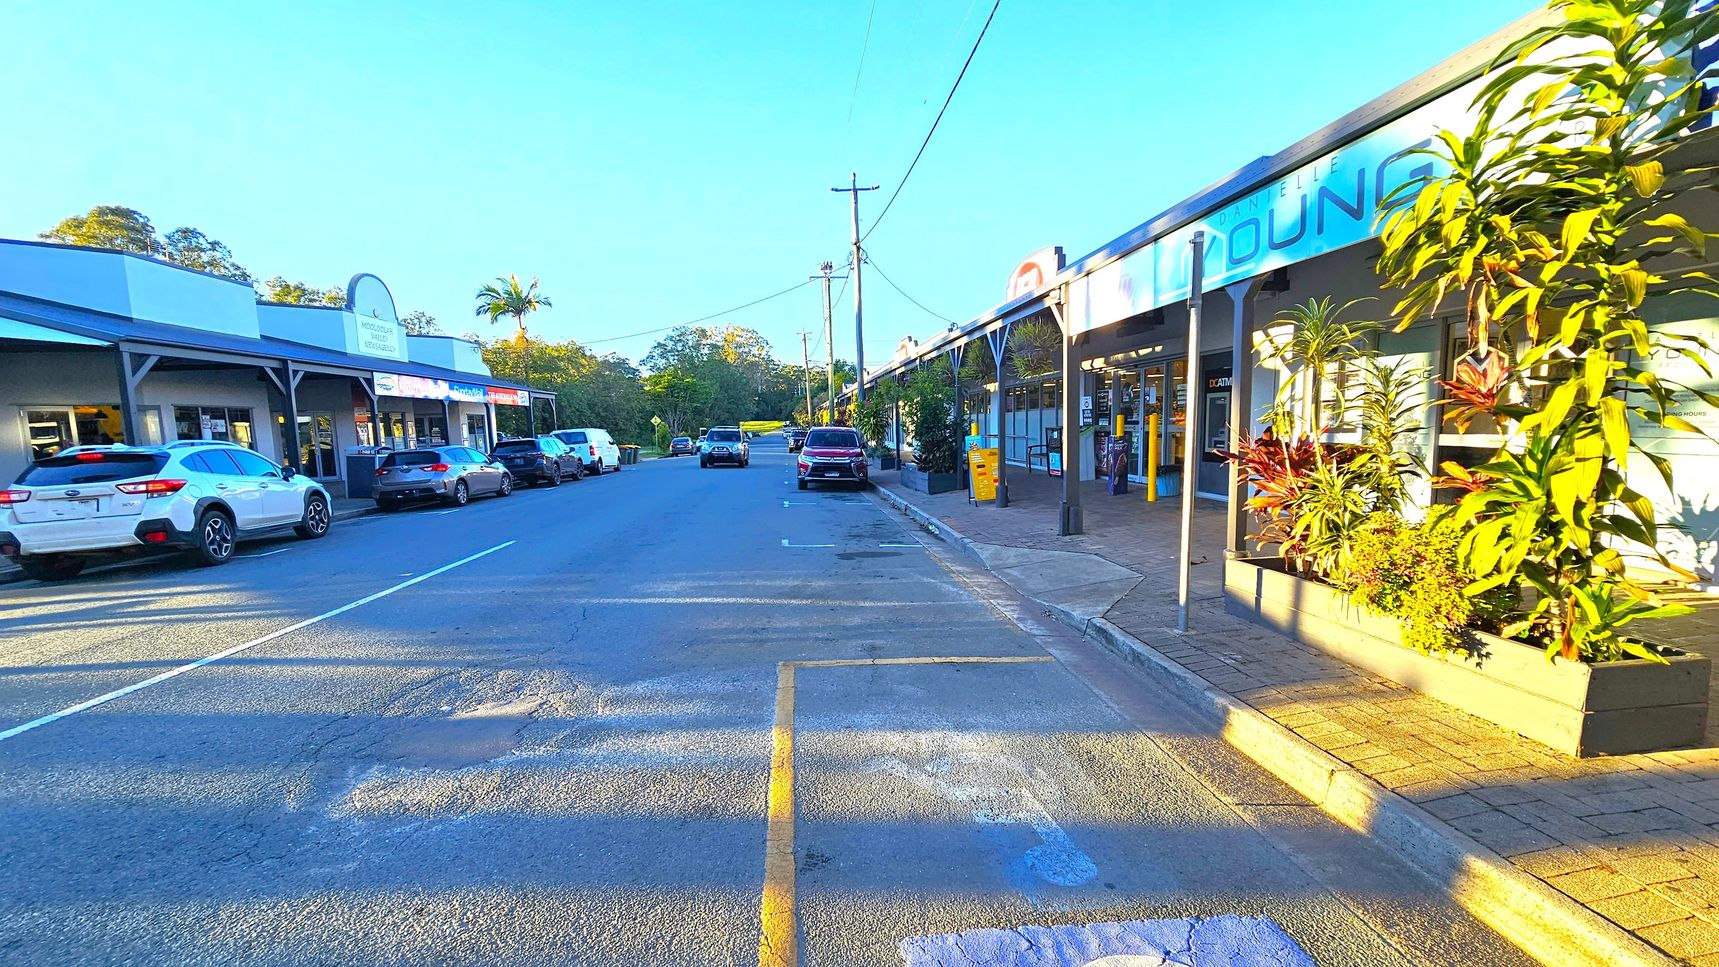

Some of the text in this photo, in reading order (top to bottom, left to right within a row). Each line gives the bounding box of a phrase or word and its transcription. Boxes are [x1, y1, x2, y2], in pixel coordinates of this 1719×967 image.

[1219, 155, 1339, 226] DANIELLE
[361, 320, 394, 336] MOOLOOLAH
[370, 332, 389, 343] VALLEY
